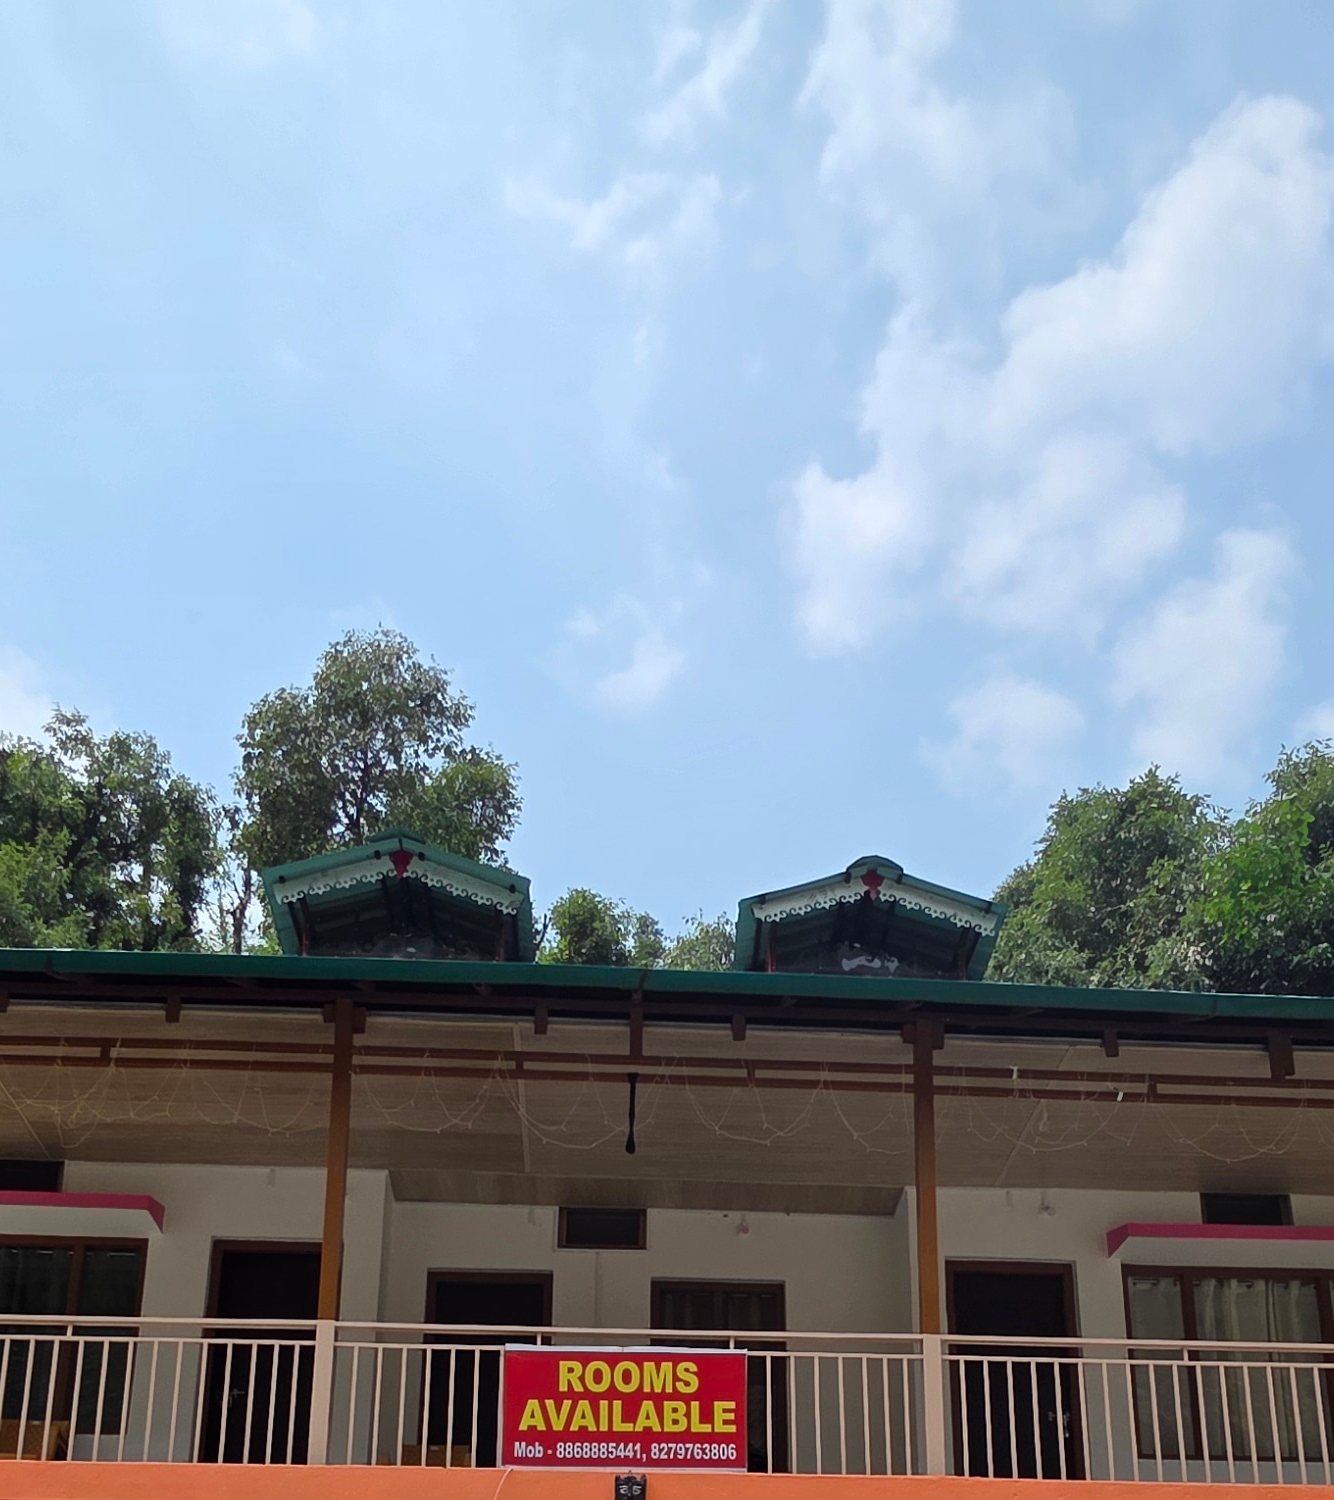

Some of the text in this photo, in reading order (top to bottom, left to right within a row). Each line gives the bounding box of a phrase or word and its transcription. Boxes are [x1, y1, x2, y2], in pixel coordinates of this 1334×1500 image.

[559, 1361, 699, 1393] ROOMS
[518, 1399, 737, 1433] AVAILABLE
[514, 1441, 543, 1458] Mob
[556, 1442, 646, 1462] 8868885441,
[651, 1443, 737, 1460] 8279763806
